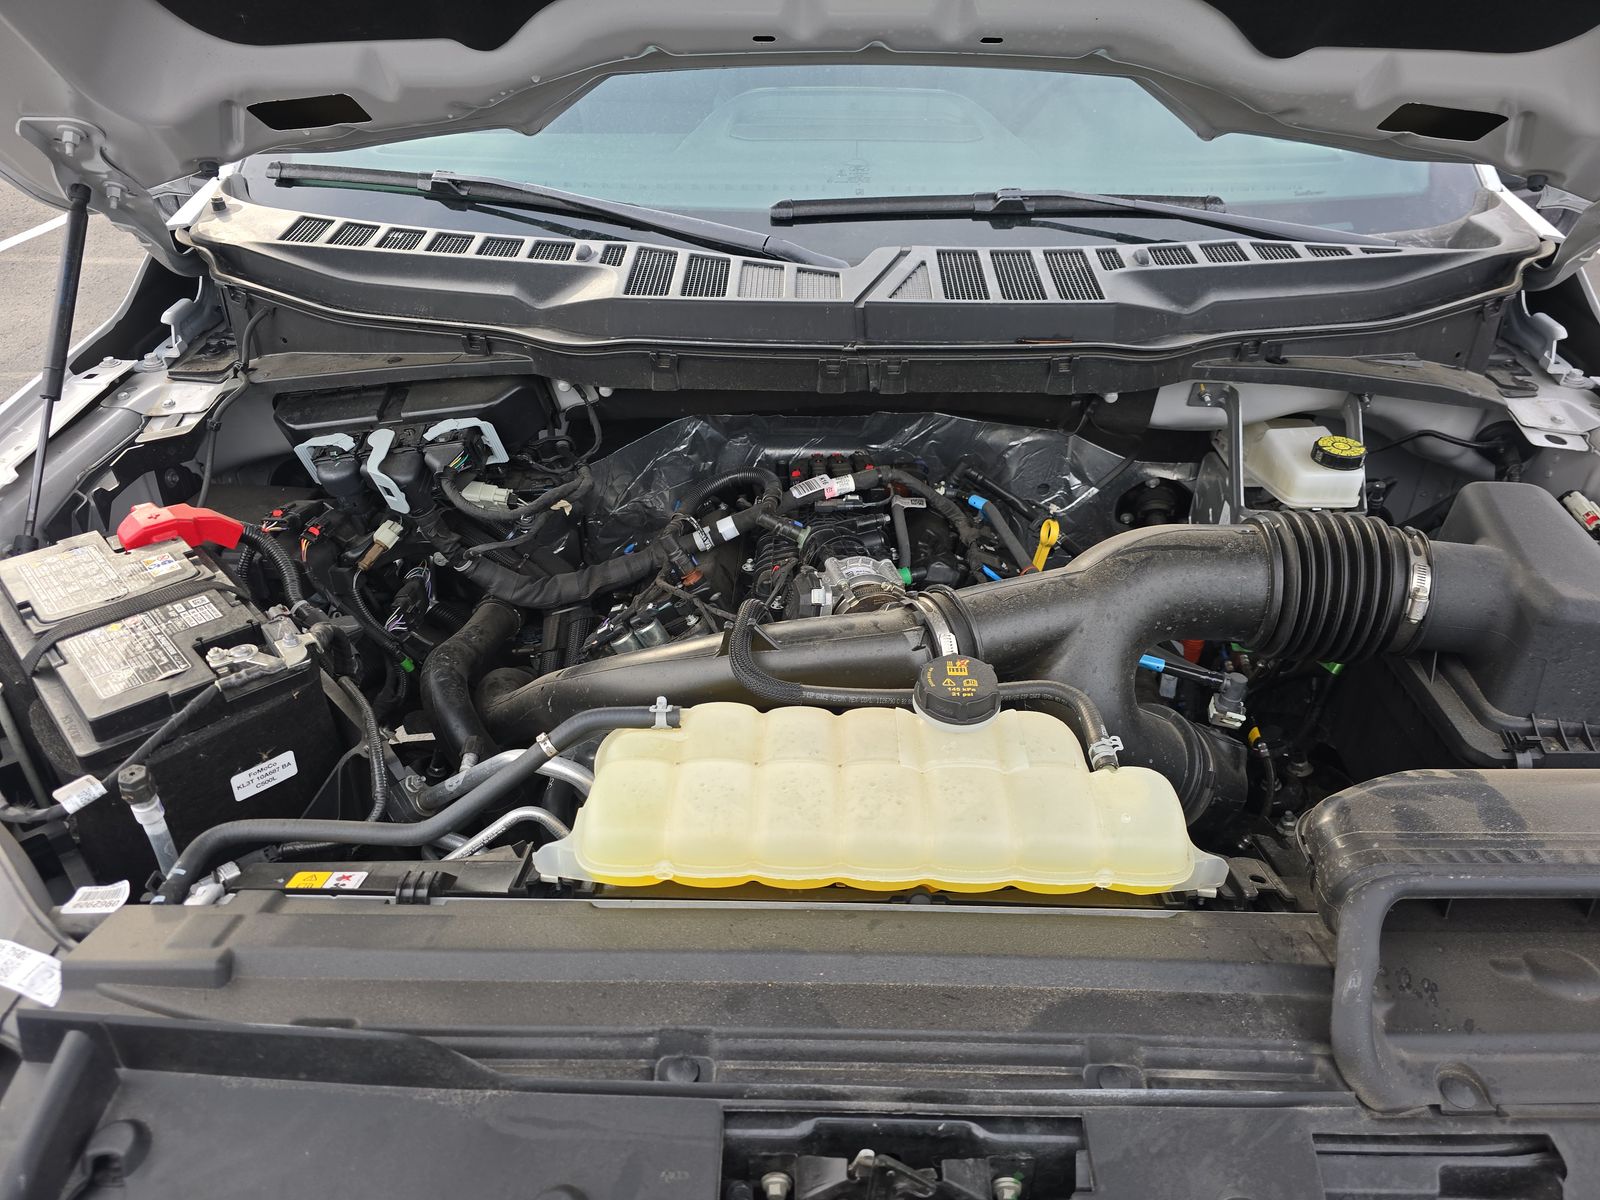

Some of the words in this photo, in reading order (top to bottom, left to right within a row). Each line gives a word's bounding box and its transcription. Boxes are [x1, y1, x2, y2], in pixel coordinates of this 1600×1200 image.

[236, 779, 254, 791] KL3T
[281, 762, 291, 770] BA
[248, 762, 278, 778] FoMoCo
[255, 777, 278, 789] C500L
